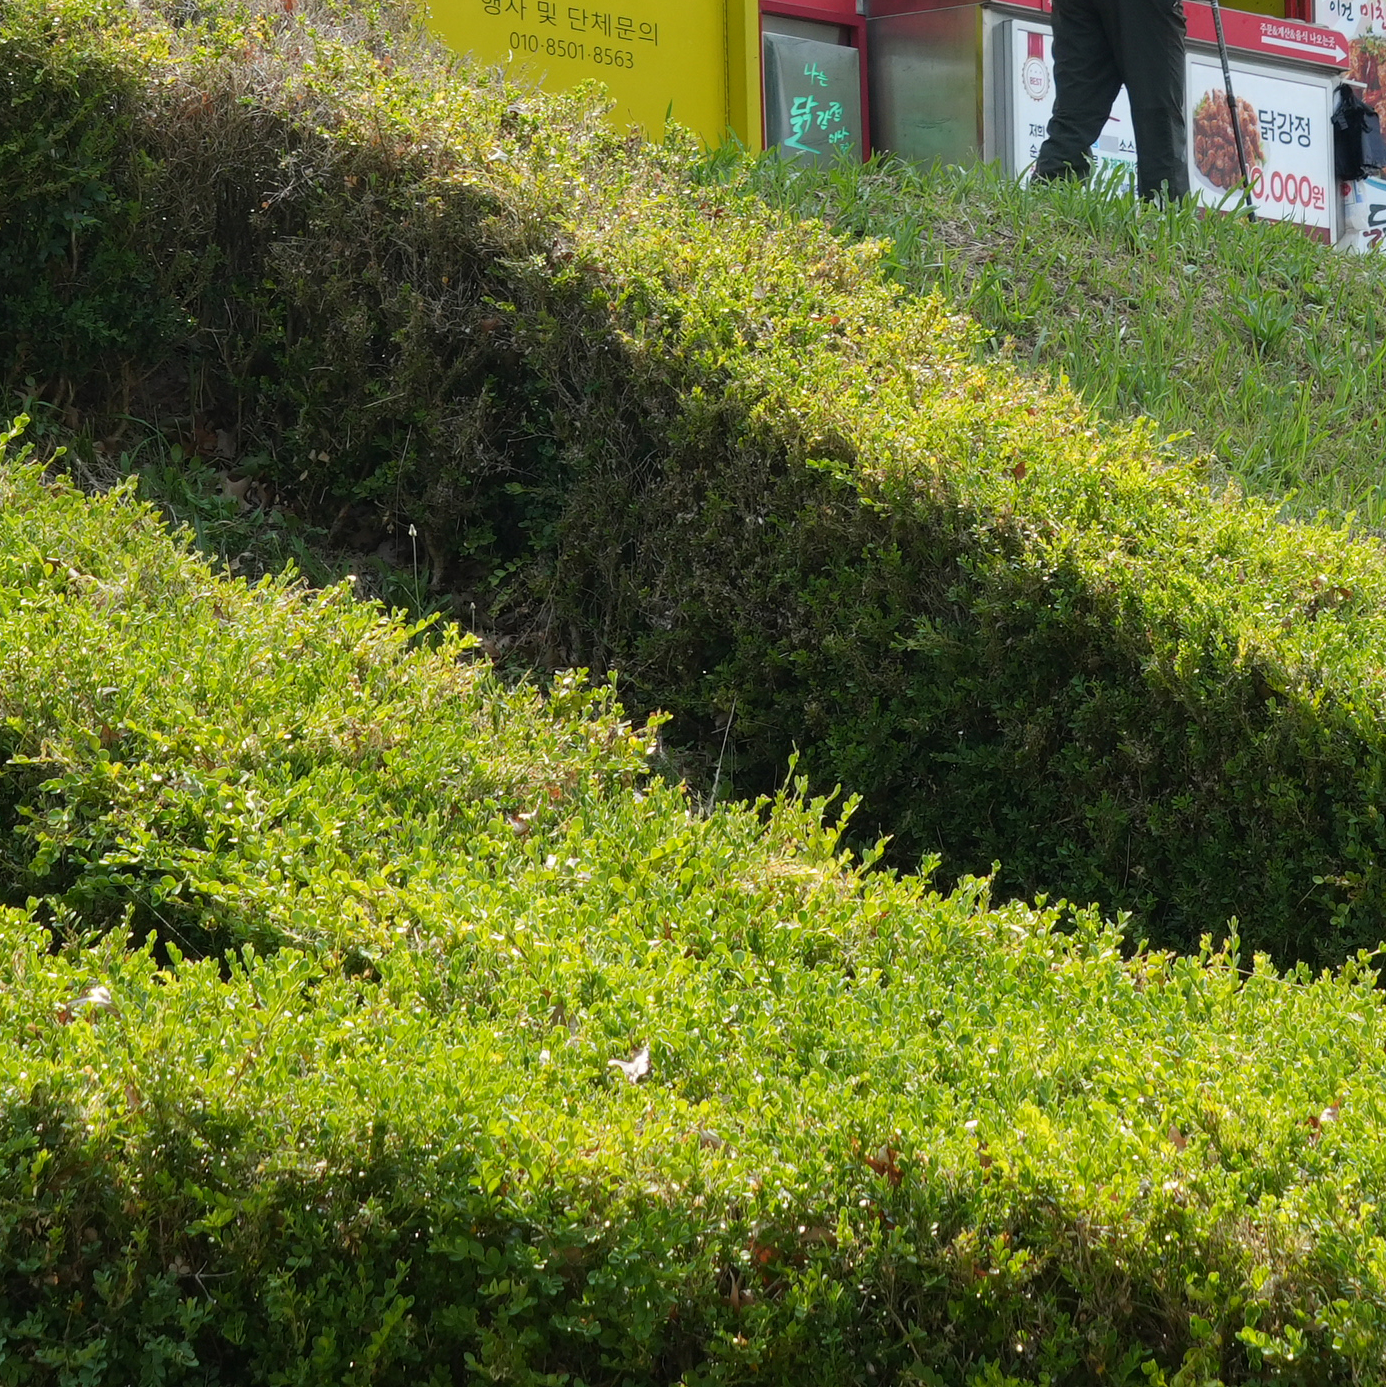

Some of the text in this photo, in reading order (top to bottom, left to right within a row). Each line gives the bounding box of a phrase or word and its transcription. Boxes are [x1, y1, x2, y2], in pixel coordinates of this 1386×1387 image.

[1329, 0, 1354, 21] 이건
[537, 0, 557, 26] 및
[568, 7, 660, 47] 단체문의
[804, 62, 829, 87] 나는
[1029, 77, 1043, 87] BEST
[1258, 109, 1312, 148] 닭강정
